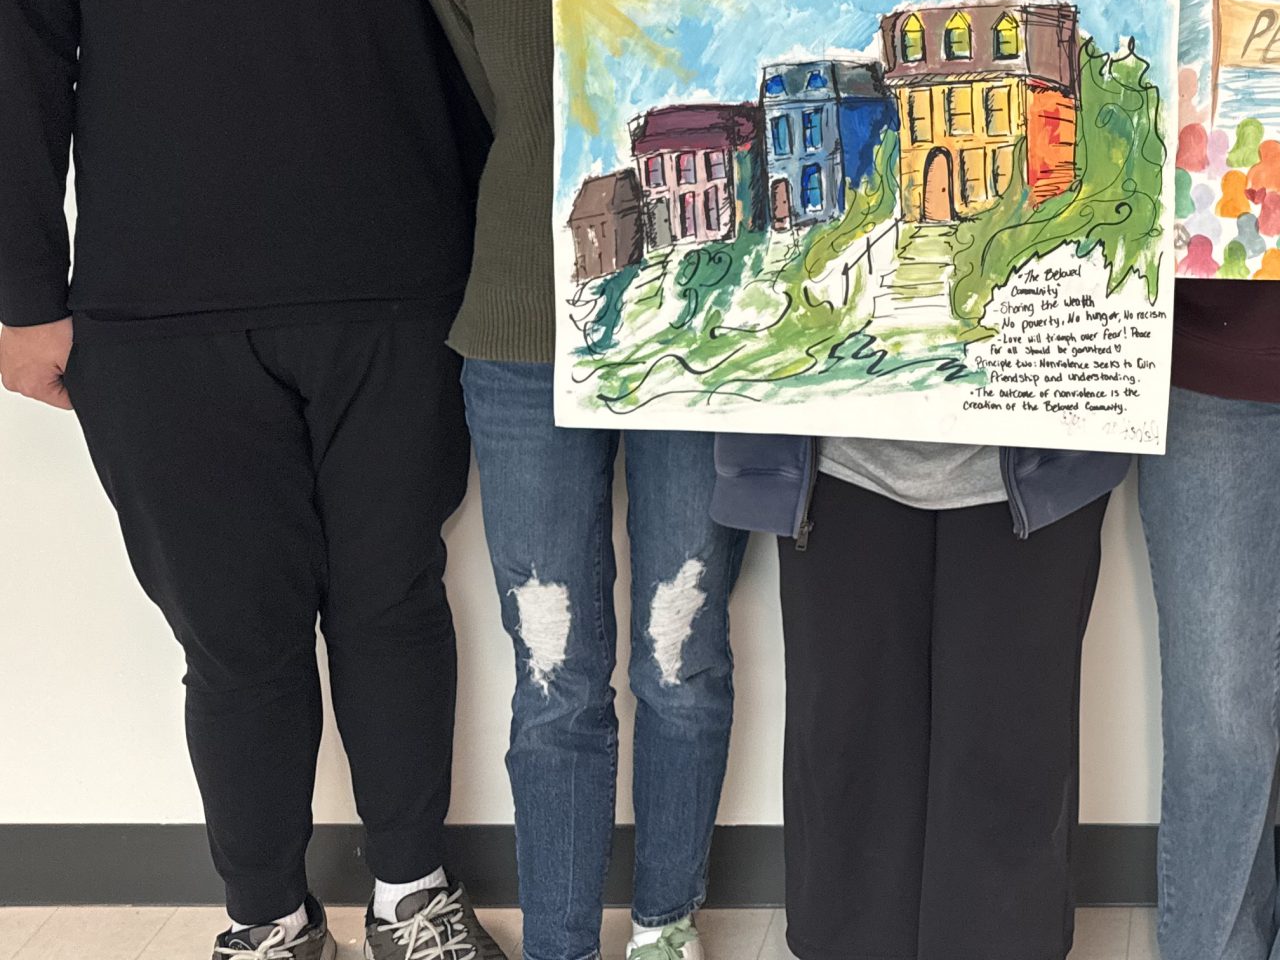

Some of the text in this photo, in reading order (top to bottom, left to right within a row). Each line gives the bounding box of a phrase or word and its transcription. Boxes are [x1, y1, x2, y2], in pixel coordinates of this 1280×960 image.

[1043, 264, 1082, 281] Beloved
[1041, 299, 1059, 311] the
[1022, 315, 1065, 333] poverty,
[1067, 311, 1081, 324] No
[1124, 309, 1134, 320] No
[1137, 310, 1167, 320] racism
[1028, 332, 1042, 343] will
[1081, 332, 1098, 342] over
[1130, 326, 1151, 339] Peace
[1007, 346, 1018, 355] all
[1057, 345, 1067, 354] be
[975, 355, 1012, 372] Principle
[1039, 358, 1090, 369] Nonviolence
[1124, 359, 1133, 369] to
[1044, 372, 1063, 383] and
[999, 388, 1036, 398] outcome
[1040, 388, 1050, 398] of
[1053, 387, 1107, 398] nonviolence
[1110, 389, 1120, 397] is
[1123, 387, 1140, 397] the
[1006, 402, 1017, 411] of
[1022, 401, 1039, 411] the
[1043, 400, 1079, 413] Beloved
